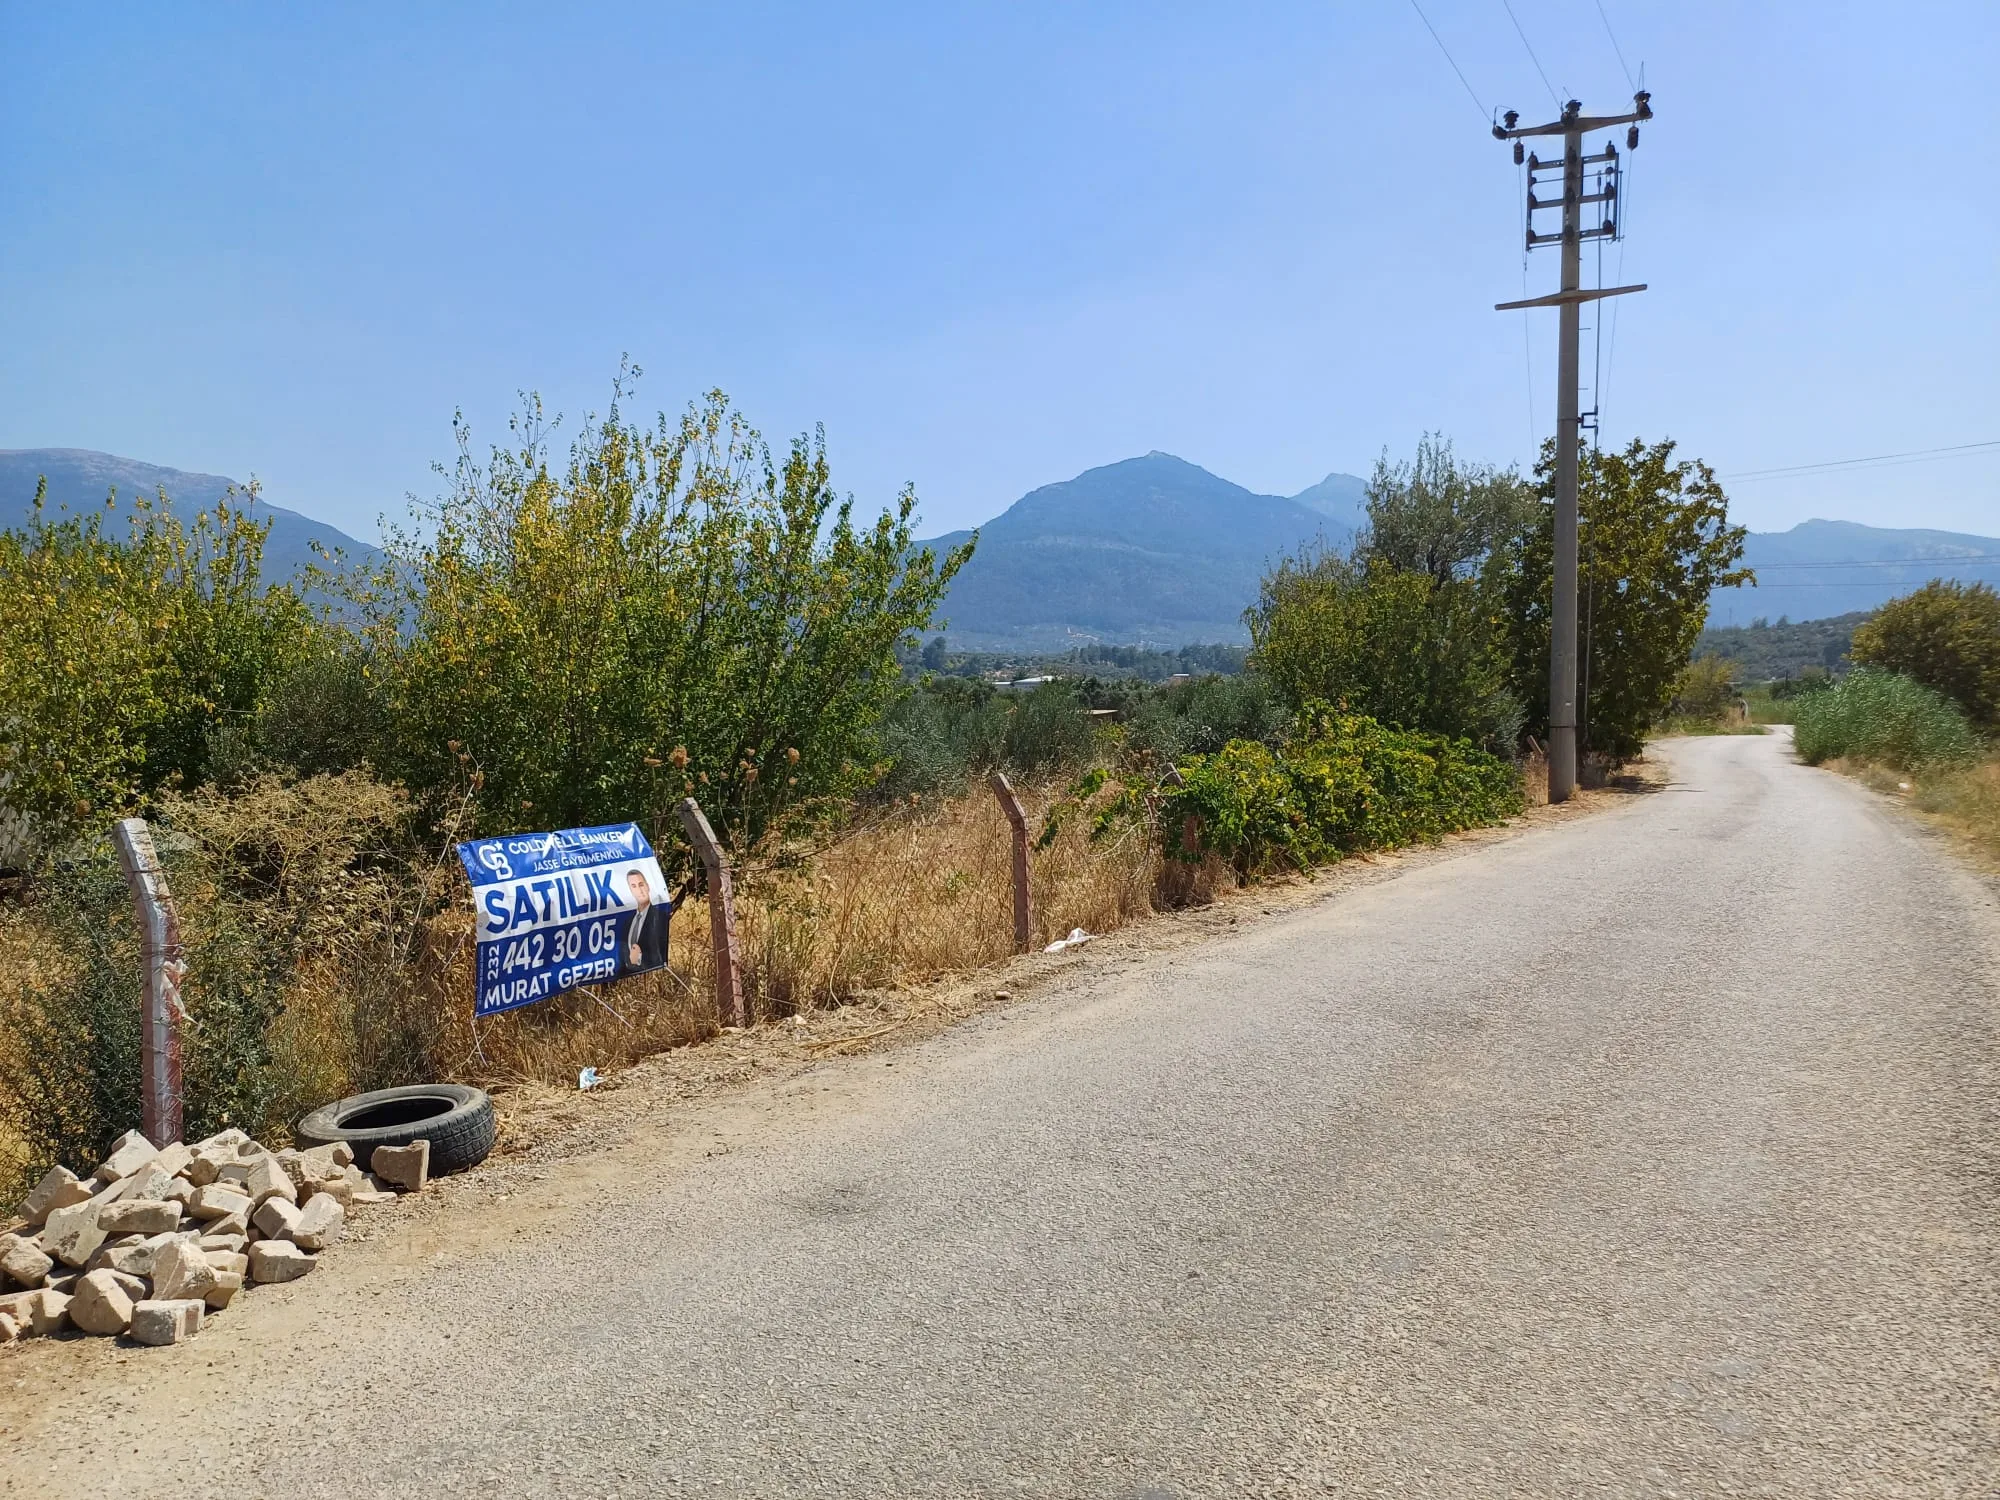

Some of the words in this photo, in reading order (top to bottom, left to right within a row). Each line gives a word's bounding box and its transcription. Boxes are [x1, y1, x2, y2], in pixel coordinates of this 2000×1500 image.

[579, 831, 625, 845] BANKER
[533, 860, 561, 872] JASSE
[485, 869, 624, 934] SATILIK
[487, 944, 500, 981] 232
[502, 933, 545, 975] 442
[551, 926, 582, 963] 30
[588, 918, 617, 955] 05
[483, 971, 552, 1010] MURAT
[558, 957, 616, 989] GEZER
